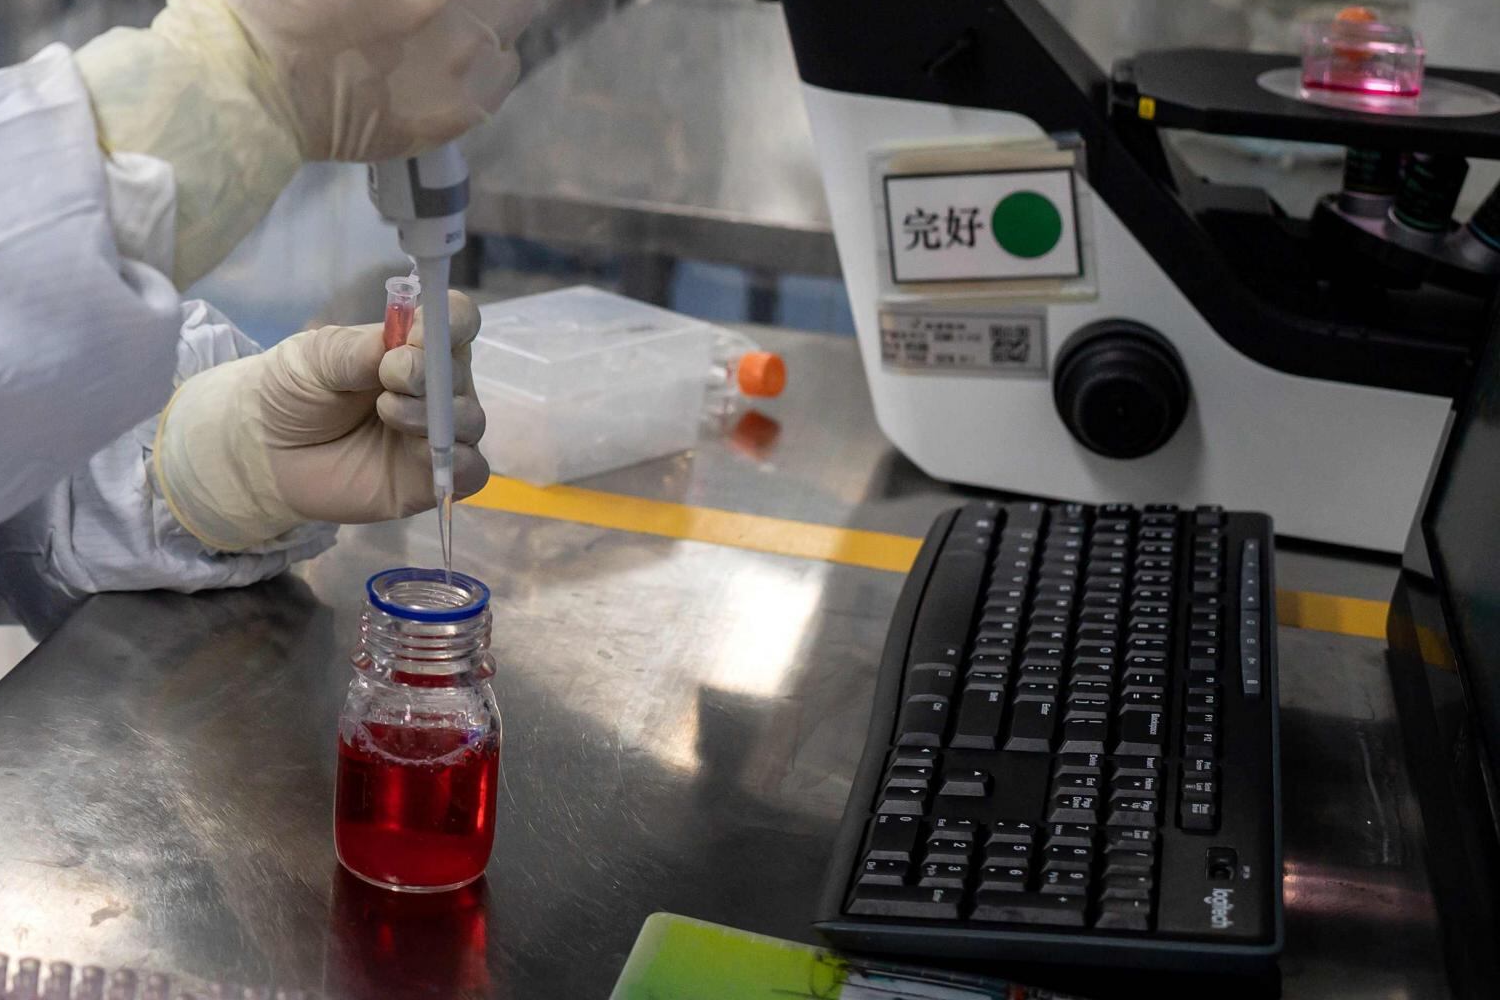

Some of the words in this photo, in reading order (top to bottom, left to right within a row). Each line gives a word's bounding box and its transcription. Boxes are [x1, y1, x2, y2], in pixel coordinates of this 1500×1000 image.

[903, 206, 984, 252] 完好
[1148, 713, 1160, 735] Backspace
[1203, 887, 1235, 929] logitech
